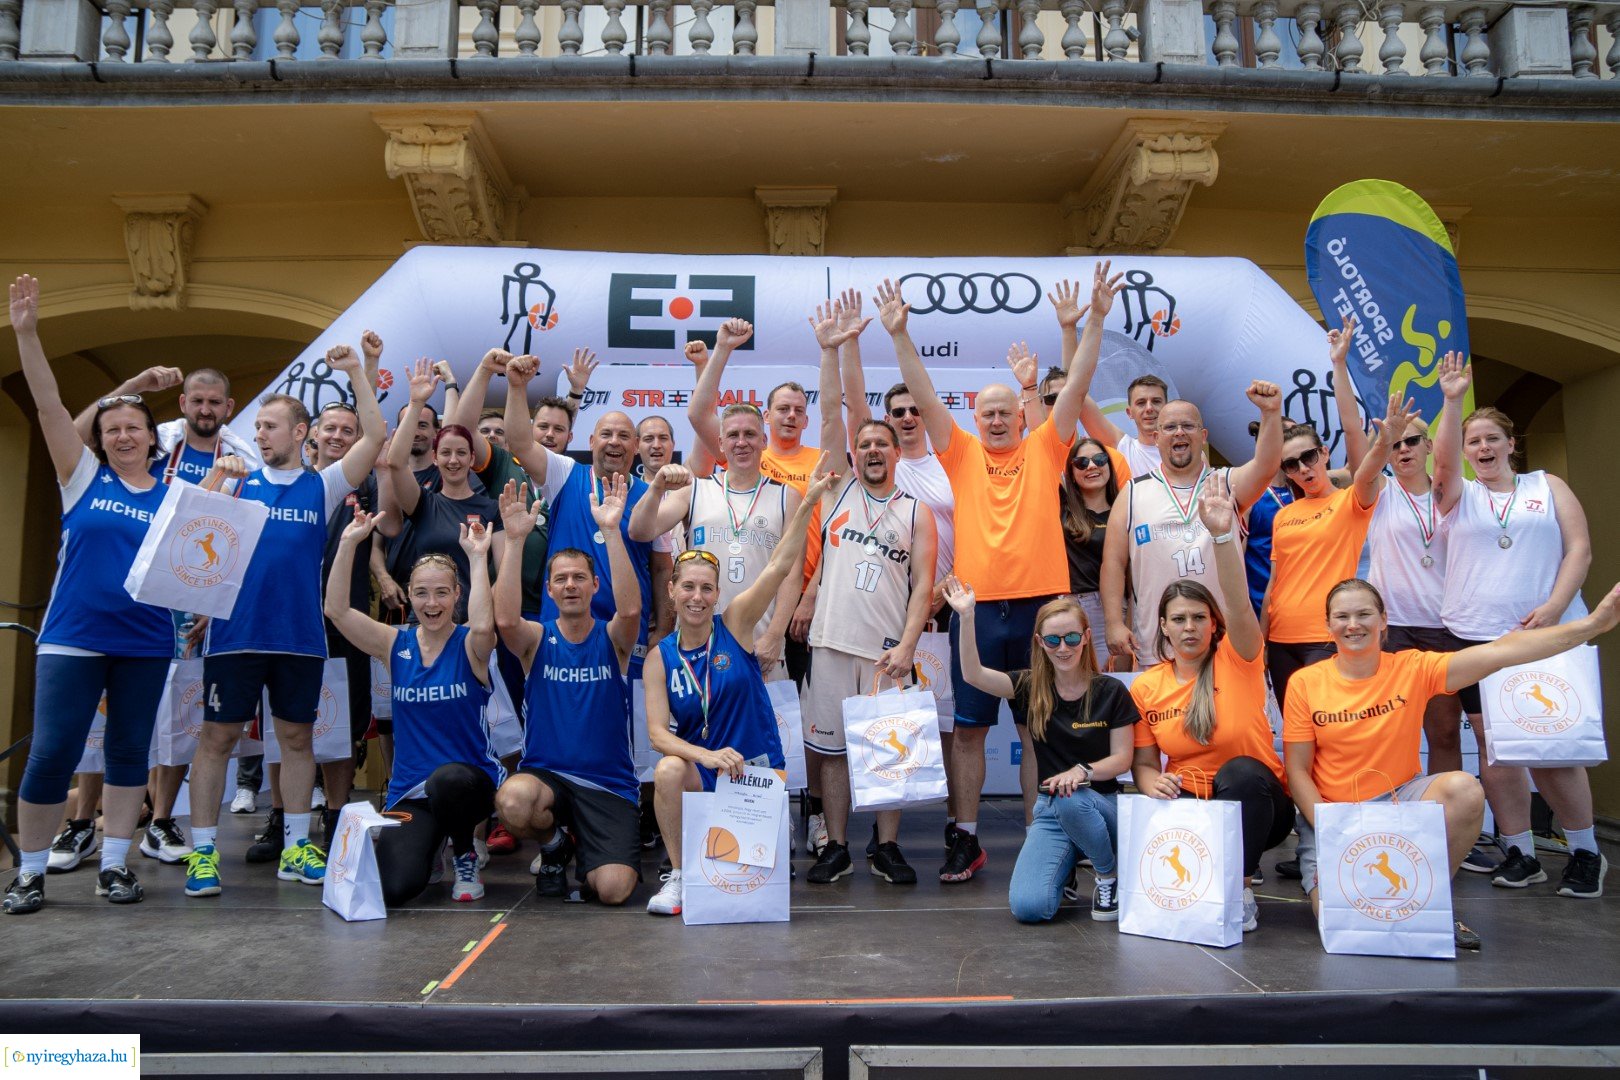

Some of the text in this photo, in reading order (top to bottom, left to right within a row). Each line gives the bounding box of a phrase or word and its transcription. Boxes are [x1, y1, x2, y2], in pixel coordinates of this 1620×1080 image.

[917, 341, 958, 357] udi
[267, 507, 318, 526] HELIN
[181, 518, 238, 549] CONTINENTAL
[841, 527, 910, 564] mondi
[727, 556, 745, 584] 5
[1171, 547, 1206, 577] 14
[176, 565, 223, 586] SINCE 1871
[855, 560, 883, 593] 17
[543, 665, 612, 683] MICHELIN
[671, 667, 693, 698] 41
[1504, 672, 1570, 694] CONTINENTAL
[208, 683, 222, 712] 4
[392, 682, 467, 702] MICHELIN
[1312, 701, 1395, 727] Continental
[1515, 717, 1574, 733] SINCE 1871
[730, 774, 774, 789] EMLÉKLAP
[873, 765, 902, 779] SINCE
[1147, 831, 1208, 862] CONTINENTAL
[1344, 835, 1423, 867] CONTINENTAL
[711, 873, 766, 893] SINCE 1871
[1147, 886, 1198, 909] SINCE 1871
[1354, 898, 1421, 920] SINCE 1871
